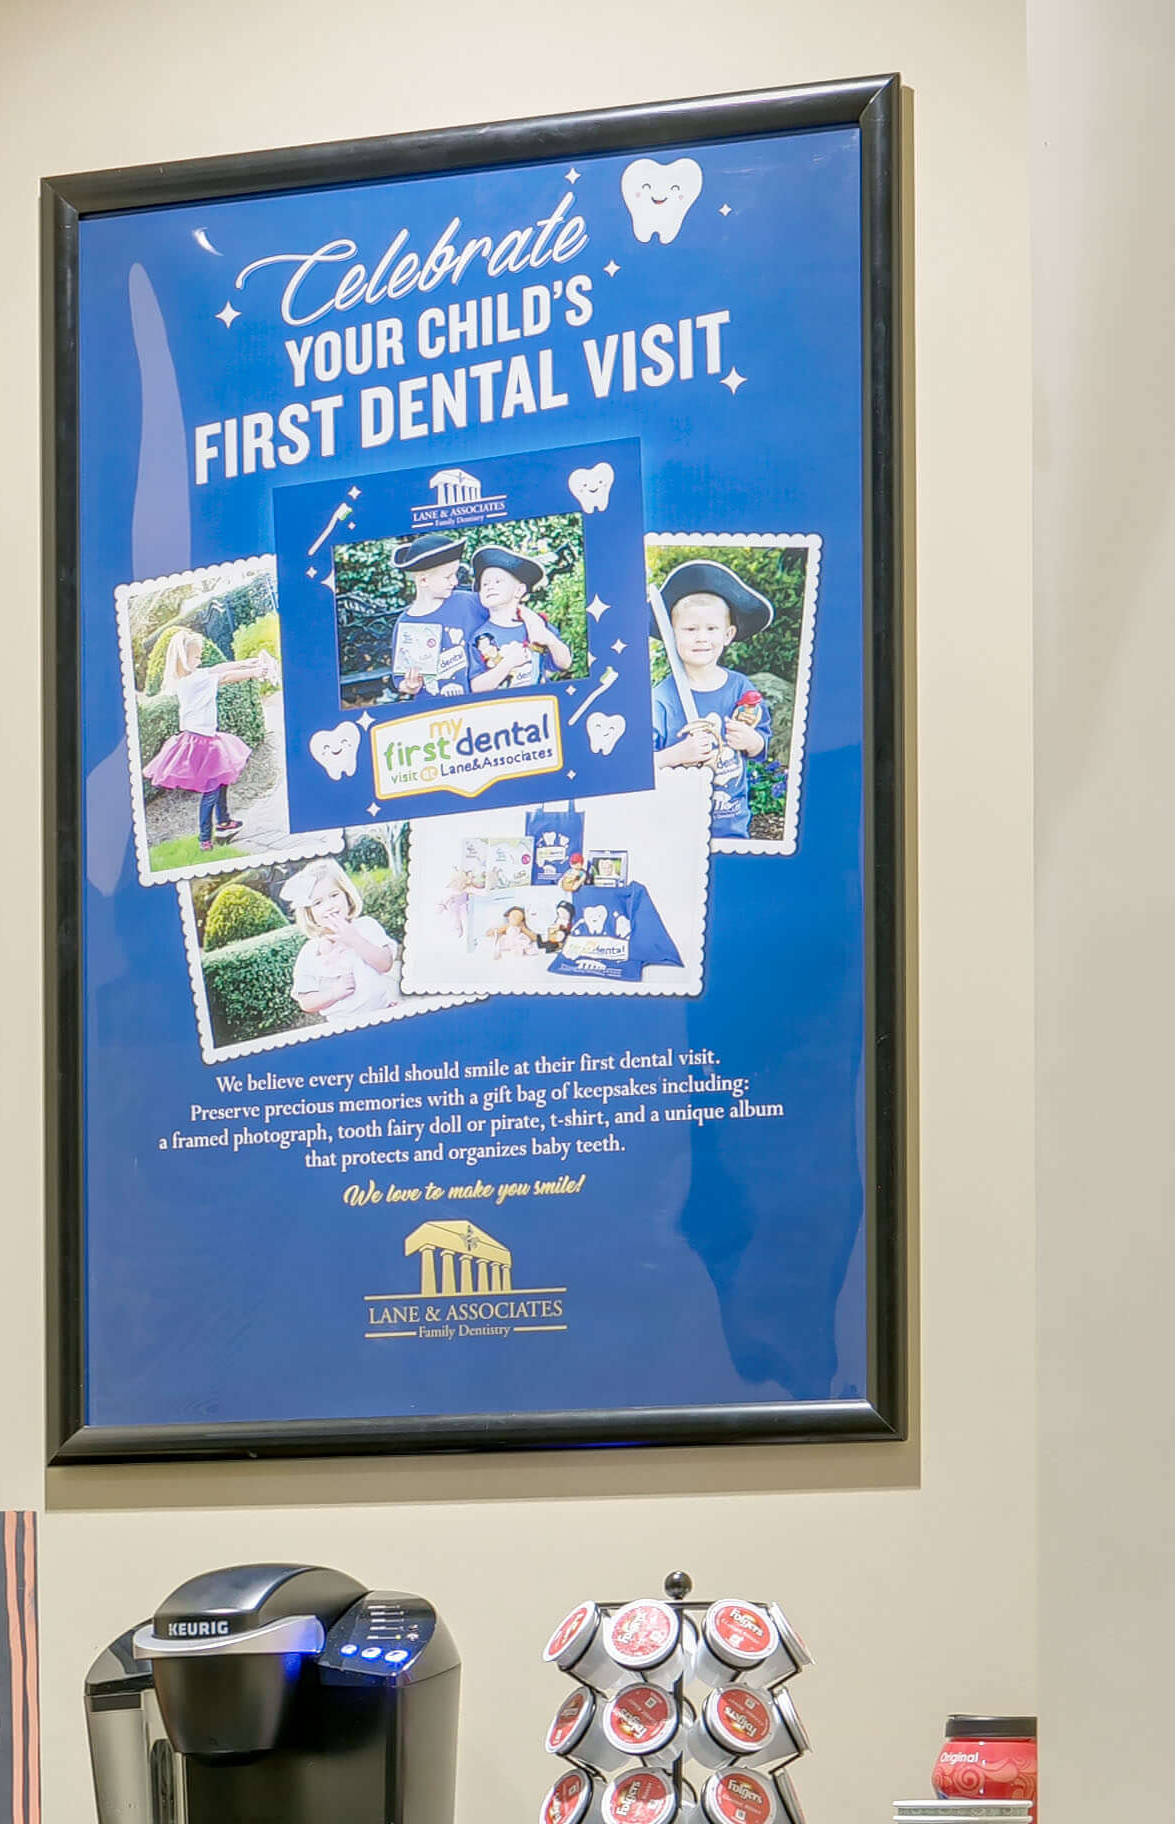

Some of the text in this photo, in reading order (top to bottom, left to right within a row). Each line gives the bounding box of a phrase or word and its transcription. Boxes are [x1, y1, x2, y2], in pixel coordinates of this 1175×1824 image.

[235, 192, 590, 328] Celebrate
[285, 275, 594, 388] YOUR CHILD'S
[194, 310, 731, 486] FIRST DENTAL VISIT
[413, 501, 506, 522] LANE & ASSOCIATES
[383, 713, 550, 771] first dental
[429, 717, 463, 741] my
[390, 770, 419, 784] visit
[216, 1048, 721, 1093] We believe every child should smile at their first dental visit.
[190, 1073, 750, 1123] Preserve precious memories with a gift bag of keepsakes including:
[158, 1099, 784, 1151] a framed photograph, tooth fairy doll or pirate, t-shirt, and a unique album
[305, 1133, 626, 1173] that protects and organizes baby teeth.
[343, 1174, 587, 1207] We love to make you smile!
[369, 1299, 563, 1325] LANE & ASSOCIATES
[418, 1323, 513, 1341] Family Dentistry
[167, 1620, 230, 1637] KEURIG
[729, 1607, 765, 1638] Folgers
[939, 1750, 980, 1766] Original
[616, 1780, 642, 1817] Folgers
[728, 1779, 763, 1805] Folgers
